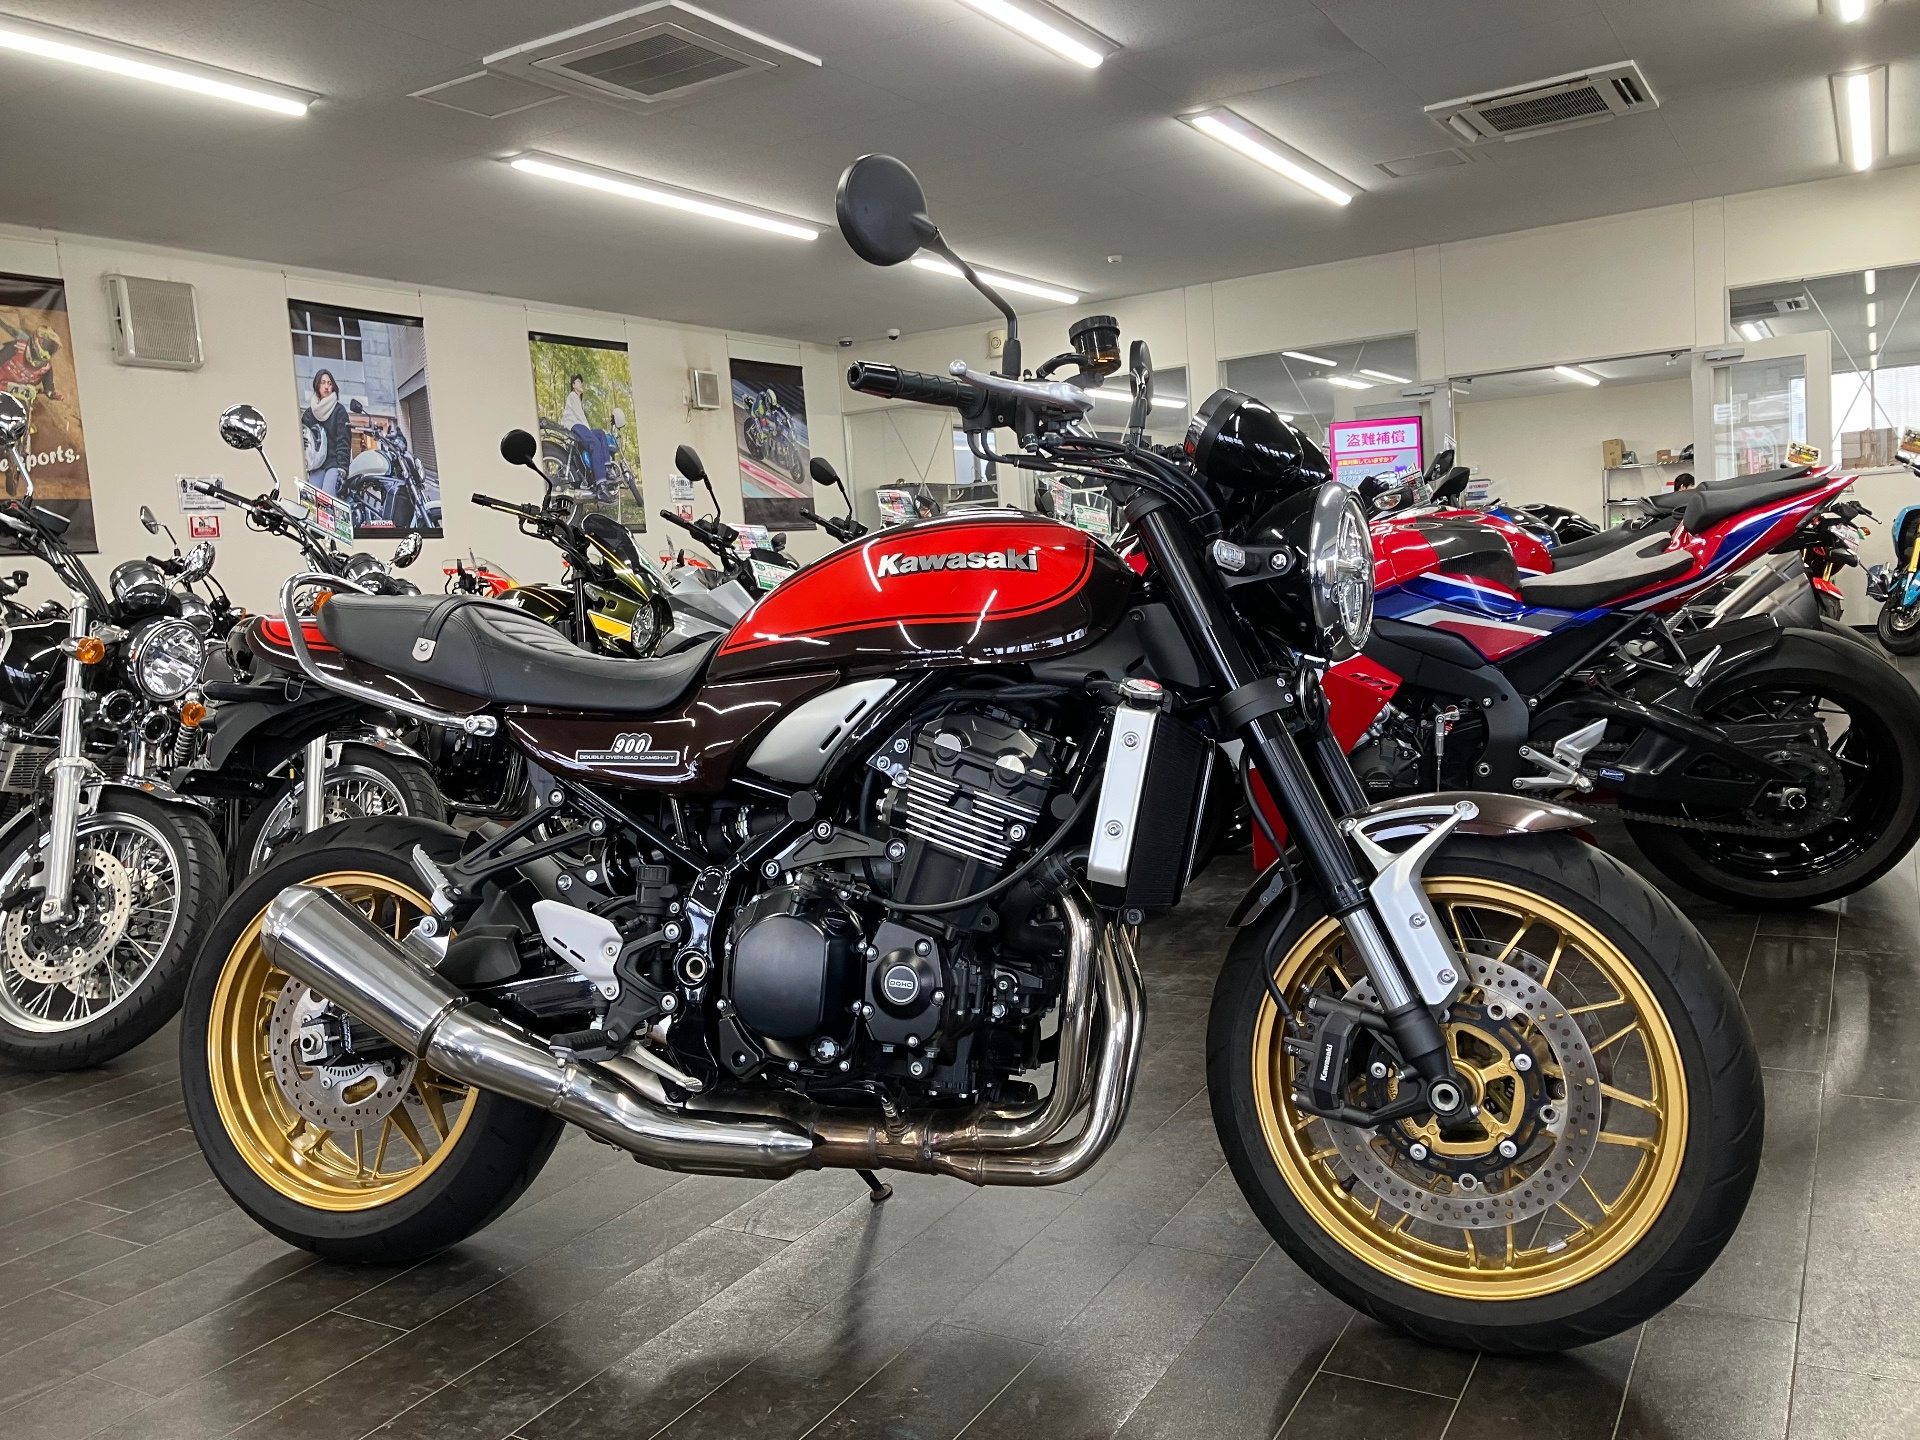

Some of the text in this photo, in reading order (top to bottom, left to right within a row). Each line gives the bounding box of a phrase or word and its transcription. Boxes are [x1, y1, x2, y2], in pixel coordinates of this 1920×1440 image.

[1346, 430, 1406, 447] 盗難補償
[877, 548, 1038, 578] Kawasaki
[614, 738, 646, 753] 900
[889, 980, 913, 988] DOHC
[1319, 1043, 1333, 1082] Kawasaki
